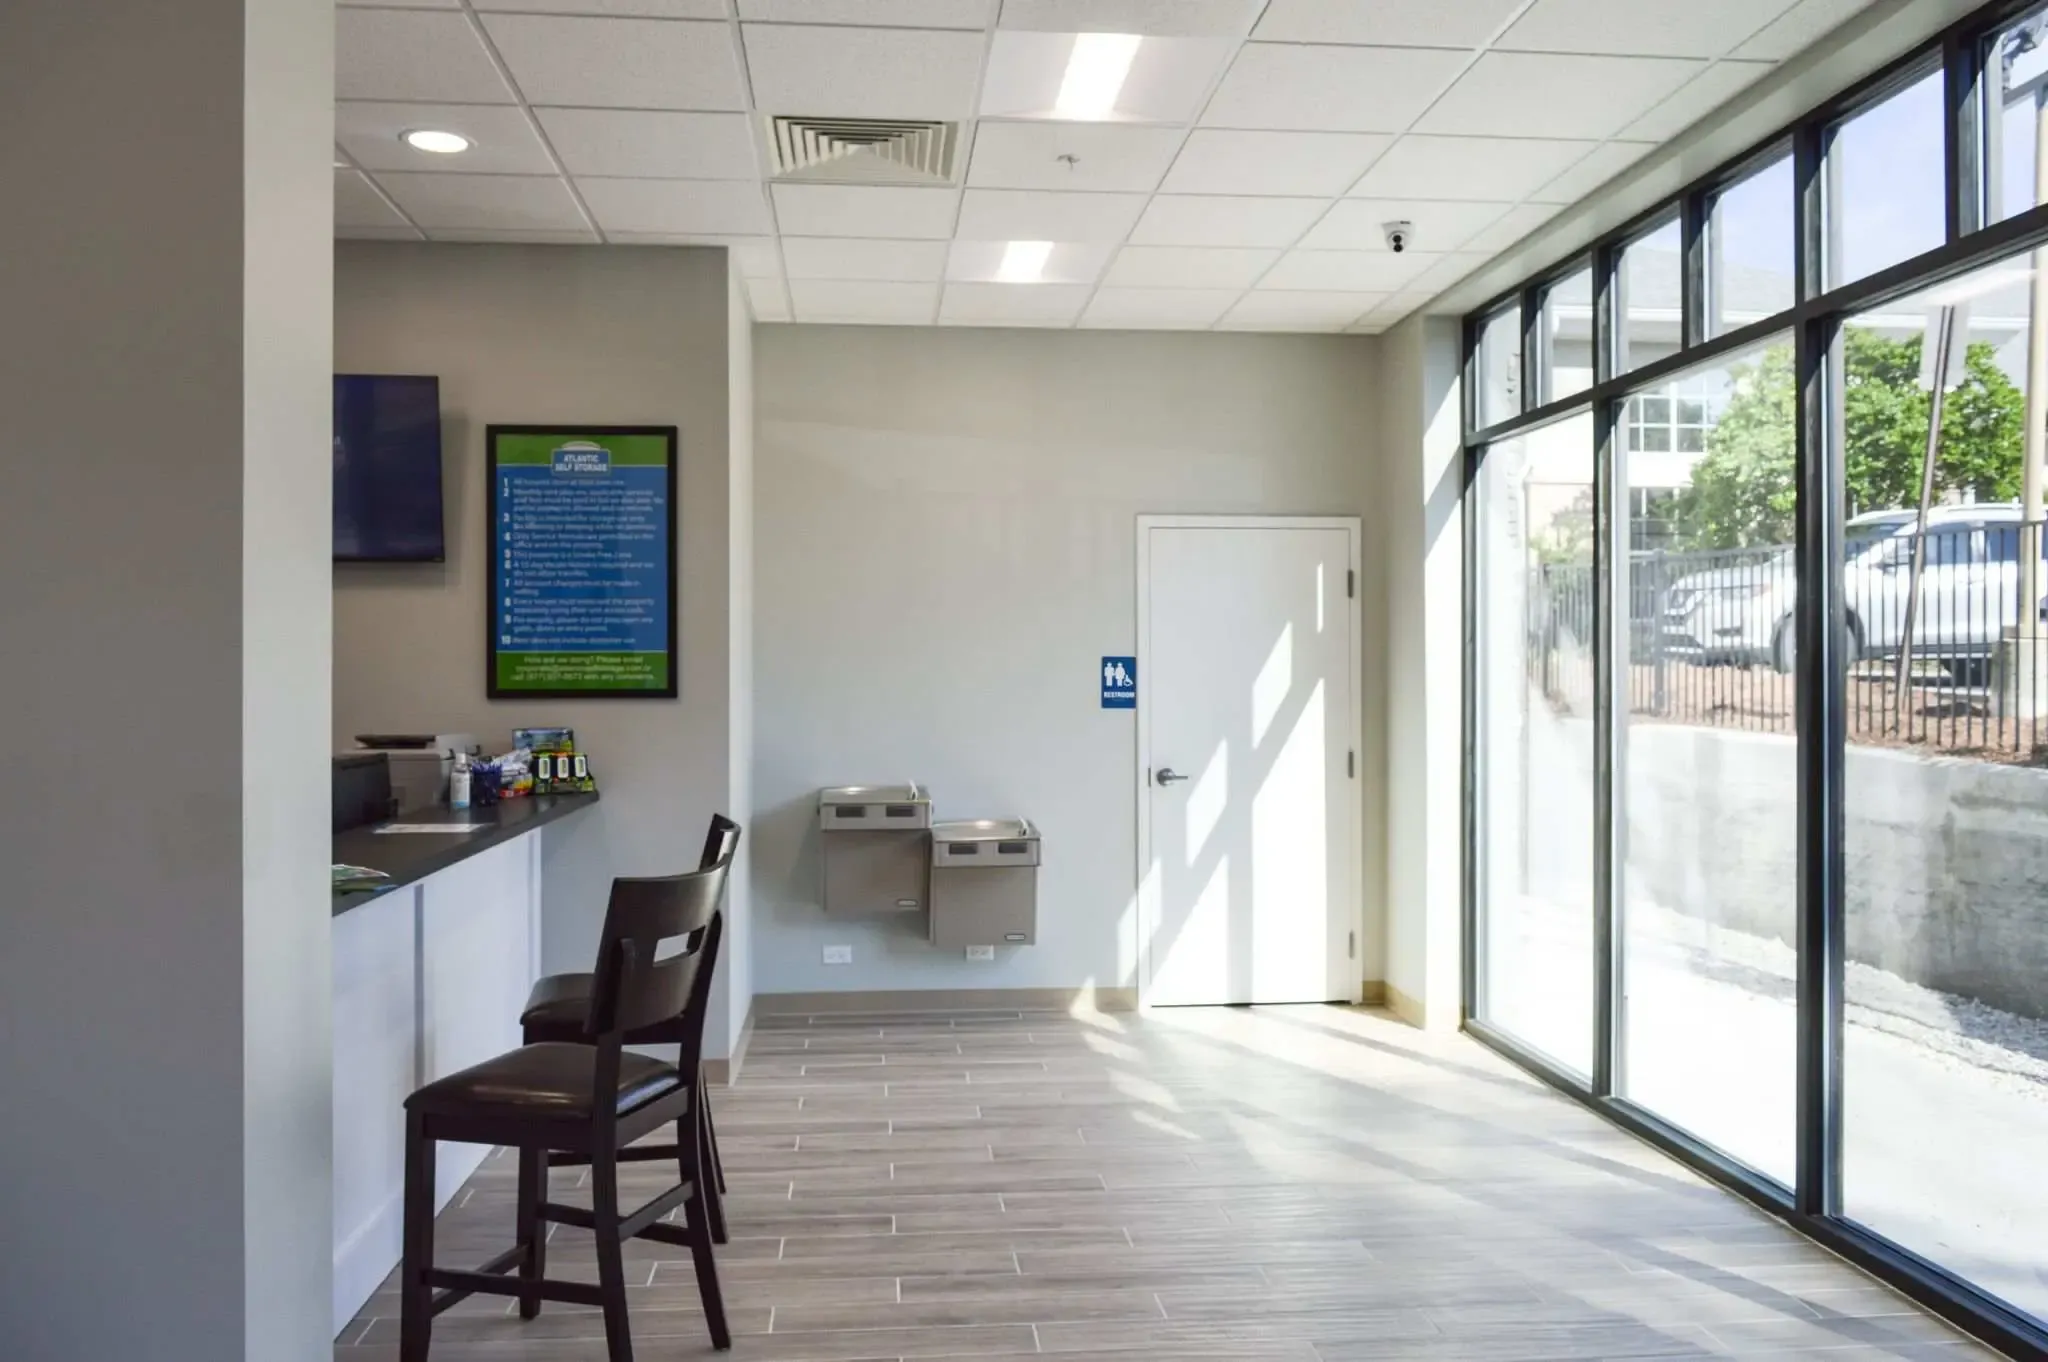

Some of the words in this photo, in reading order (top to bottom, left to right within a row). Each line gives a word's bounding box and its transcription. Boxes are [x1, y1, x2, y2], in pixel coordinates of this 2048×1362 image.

[564, 454, 599, 462] ATLANTIC
[555, 463, 571, 472] SELF
[574, 463, 608, 472] STORAGE
[501, 636, 511, 645] 10
